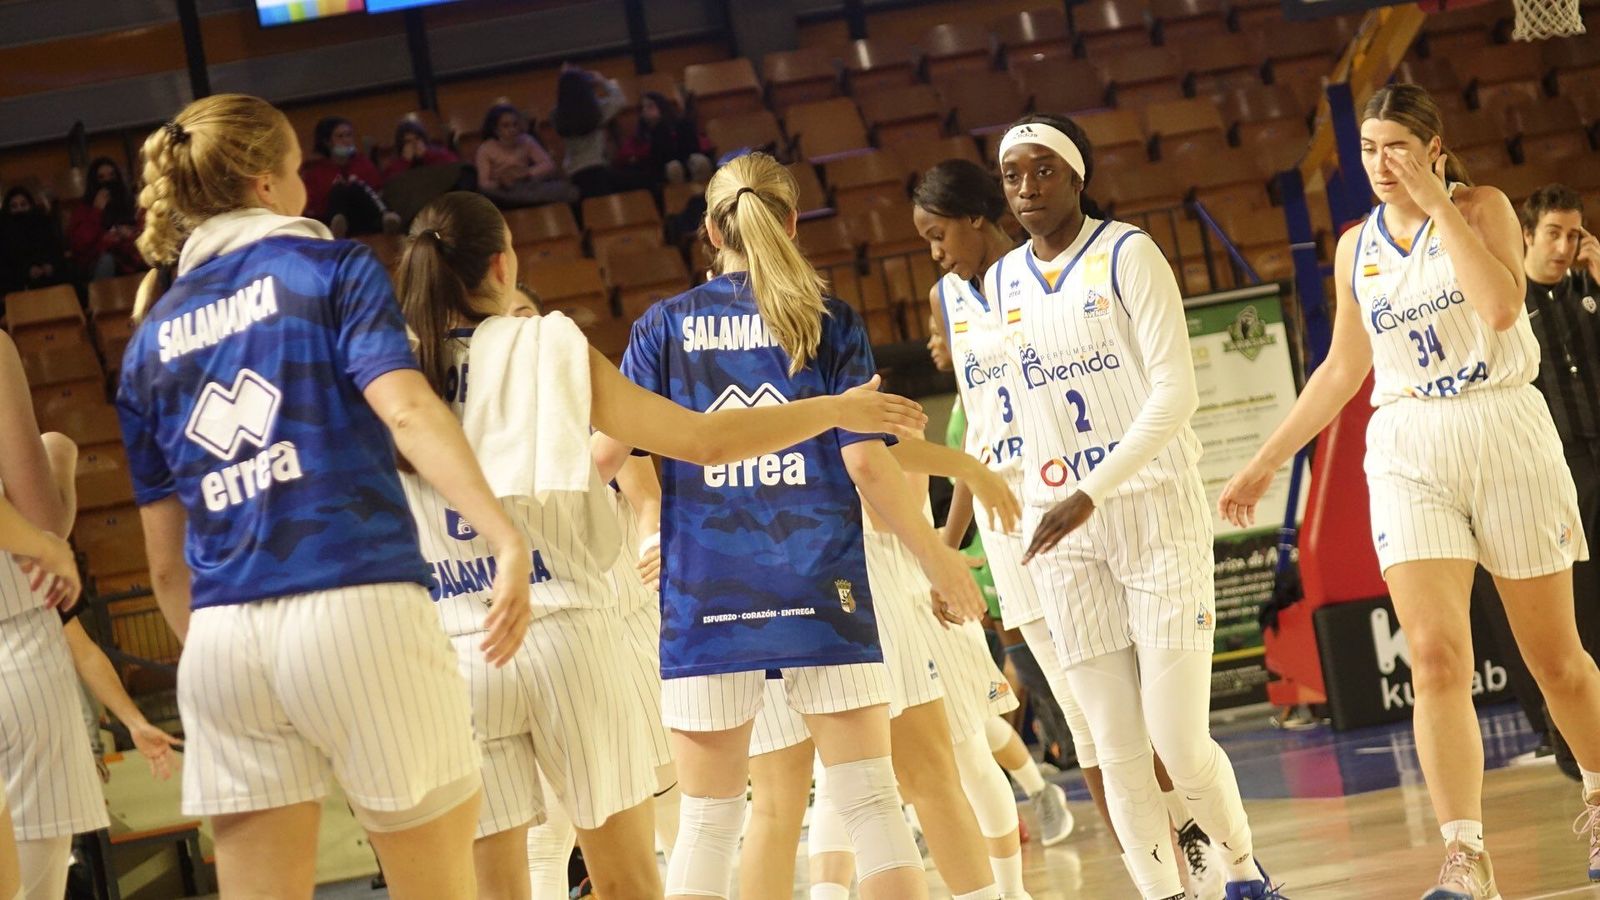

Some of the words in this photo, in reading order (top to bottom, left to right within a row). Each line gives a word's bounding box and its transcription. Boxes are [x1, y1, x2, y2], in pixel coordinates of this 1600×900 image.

[158, 275, 279, 363] SALAMANCA
[1408, 323, 1446, 368] 34
[997, 385, 1014, 424] 3
[1065, 388, 1093, 434] 2
[703, 613, 738, 625] ESFUERZO
[741, 608, 778, 620] CORAZÓN
[781, 607, 816, 618] ENTREGA
